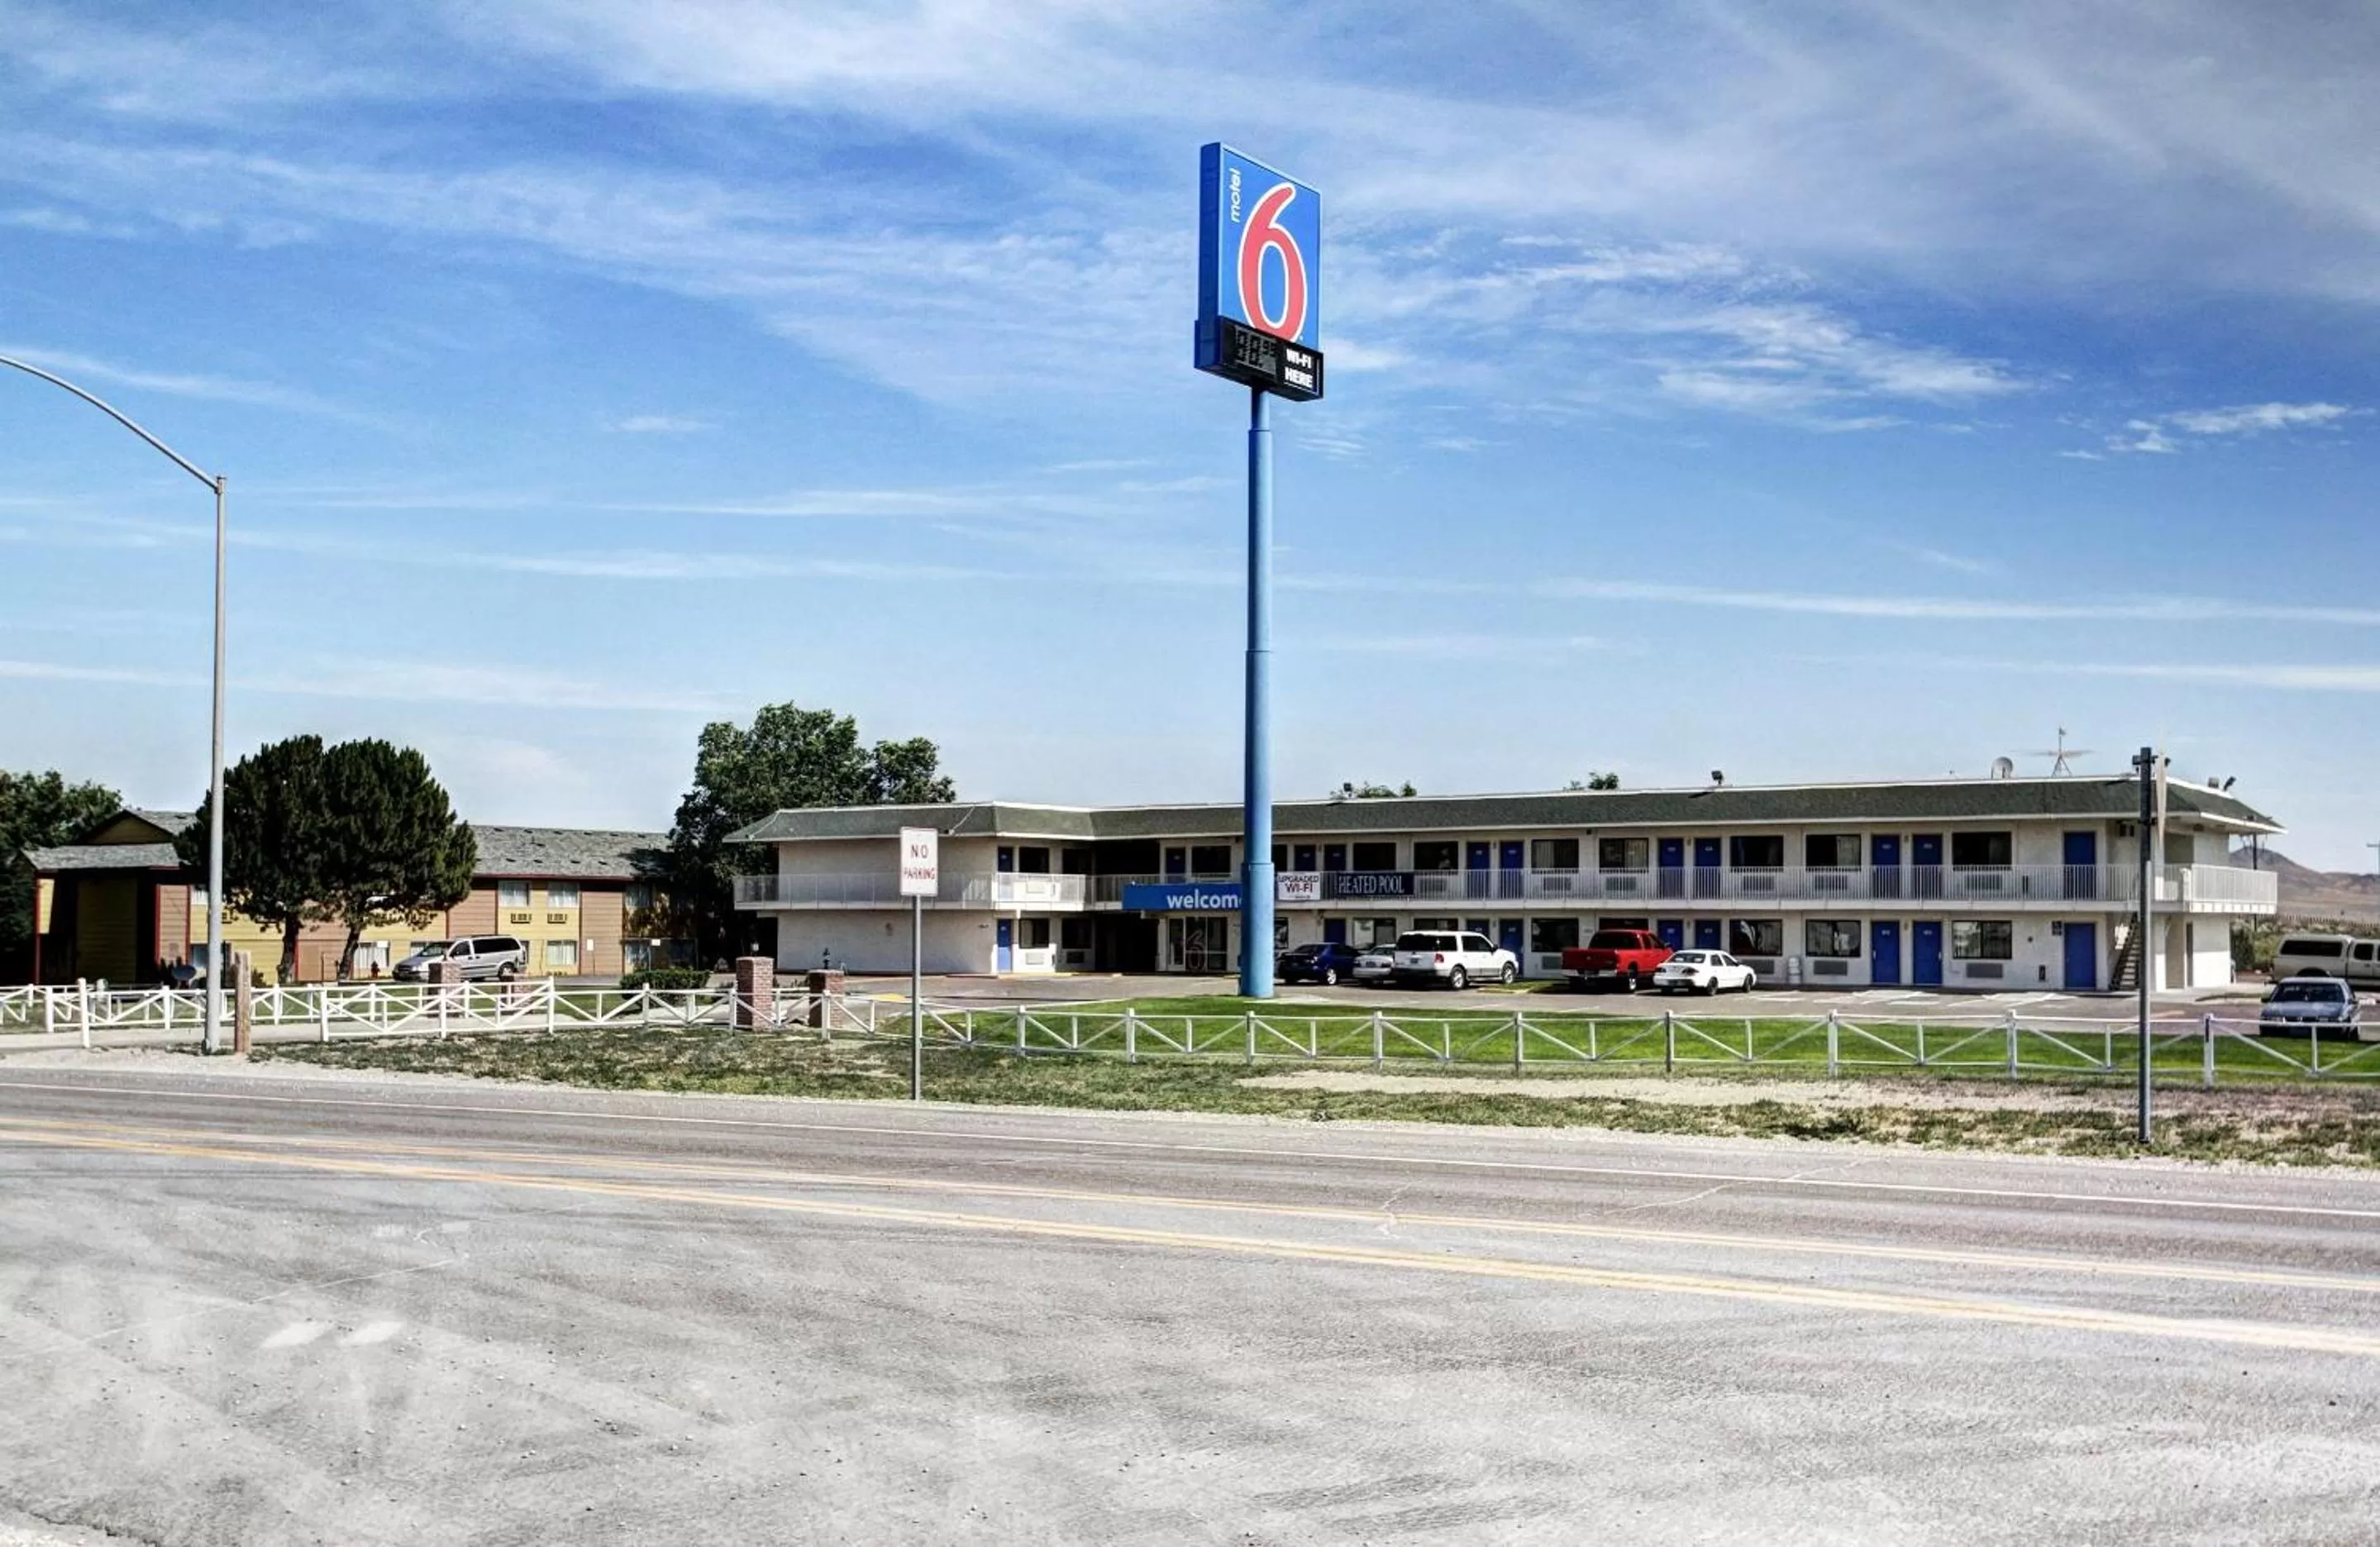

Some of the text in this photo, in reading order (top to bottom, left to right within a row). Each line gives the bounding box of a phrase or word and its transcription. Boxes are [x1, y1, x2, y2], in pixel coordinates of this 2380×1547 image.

[1228, 167, 1308, 343] motel 6
[1285, 348, 1312, 369] WI-FI
[1285, 367, 1314, 389] HERE
[910, 844, 929, 859] NO
[904, 867, 936, 881] PARKING
[1277, 875, 1319, 883] UPGRADED
[1285, 883, 1313, 893] WI-FI
[1338, 875, 1405, 894] HEATED POOL
[1166, 888, 1242, 909] welcom
